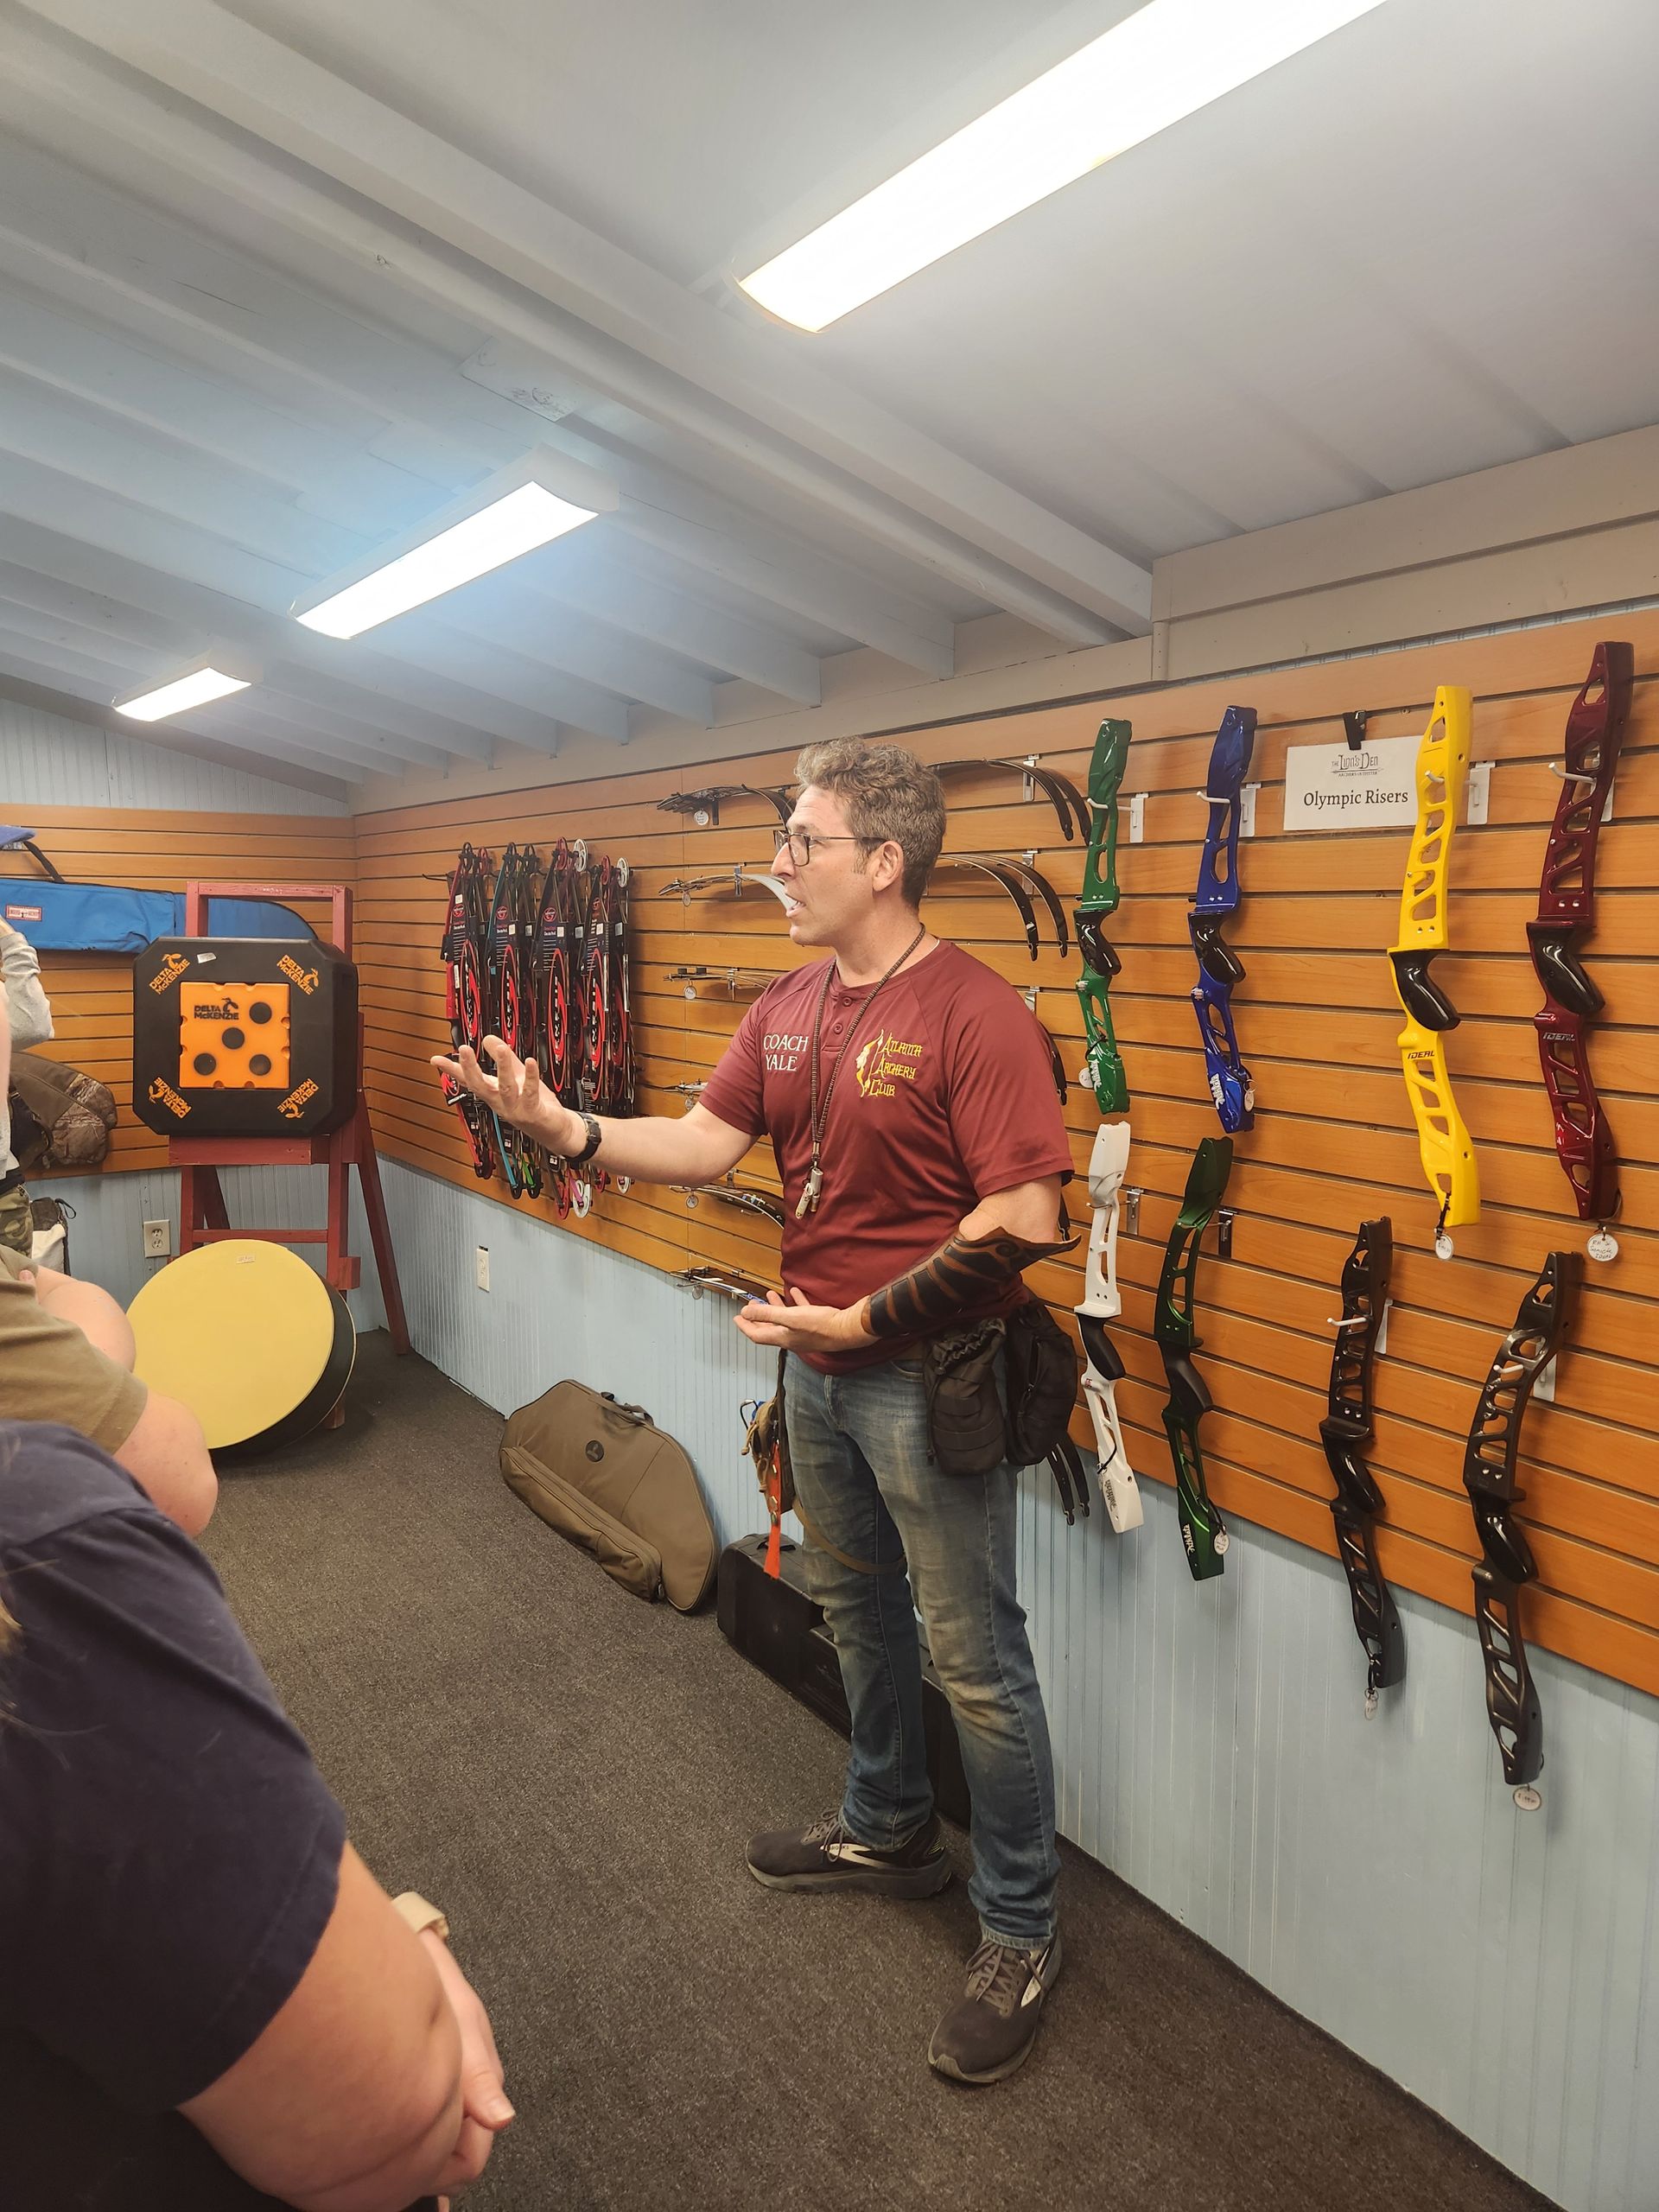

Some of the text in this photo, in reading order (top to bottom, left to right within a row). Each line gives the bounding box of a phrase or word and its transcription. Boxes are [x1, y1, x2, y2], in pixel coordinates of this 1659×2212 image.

[1304, 789, 1408, 810] Olympic Risers
[156, 958, 190, 995] McKENZIE
[282, 954, 304, 978] DELTA
[149, 968, 173, 989] DELTA
[276, 960, 314, 995] McKENZIE
[194, 1012, 239, 1020] McKENZIE
[763, 1033, 809, 1052] COACH
[1543, 1032, 1575, 1041] IDEAL
[765, 1054, 798, 1071] YALE
[1408, 1050, 1435, 1059] IDEAL
[154, 1077, 191, 1113] McKENZIE
[277, 1078, 315, 1113] McKENZIE
[295, 1084, 319, 1104] DELTA
[163, 1094, 187, 1118] DELTA
